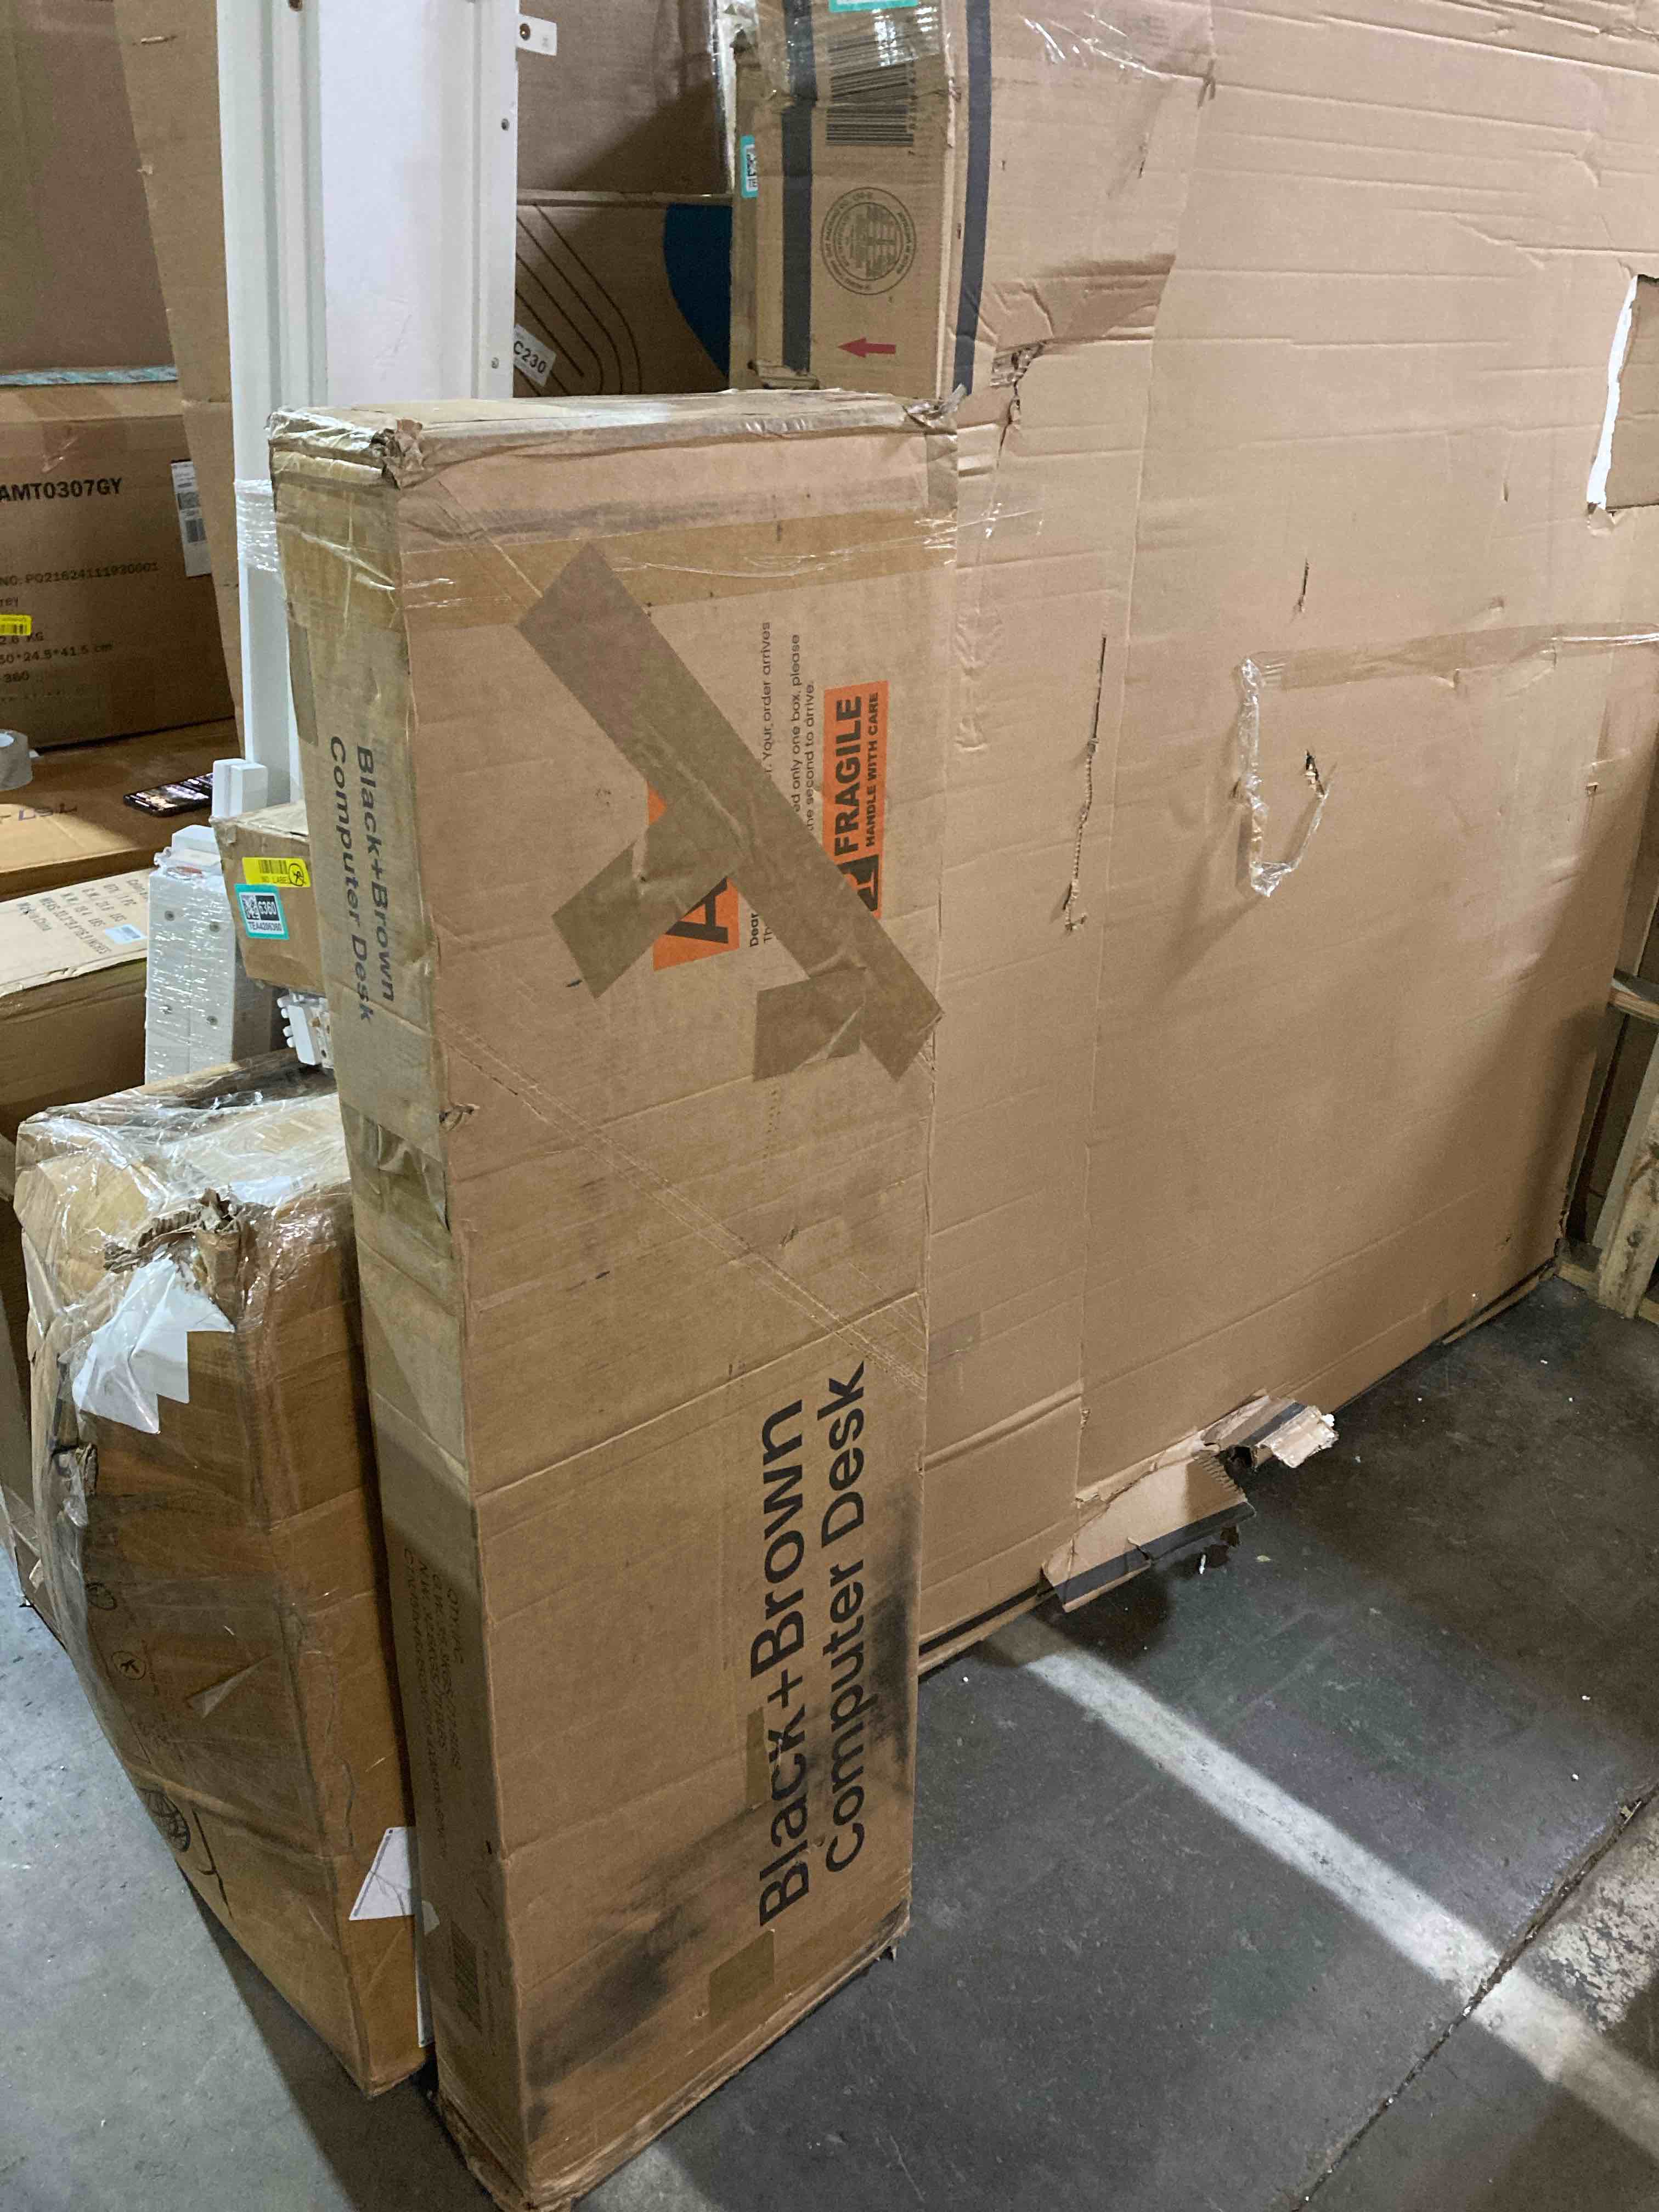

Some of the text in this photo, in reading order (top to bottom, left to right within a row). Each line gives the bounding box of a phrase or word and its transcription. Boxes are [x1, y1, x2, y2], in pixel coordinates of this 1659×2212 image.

[514, 340, 546, 374] C230
[761, 622, 771, 675] arrives
[790, 634, 802, 686] please
[761, 682, 772, 722] order
[792, 726, 801, 754] one
[804, 731, 814, 747] to
[791, 759, 803, 789] only
[804, 751, 814, 805] second
[834, 696, 862, 857] FRAGILE
[865, 692, 879, 847] HANDLE WITH CARE
[331, 736, 374, 1022] Computer Desk
[358, 745, 394, 1002] Black+Brown
[257, 901, 278, 916] 6360
[749, 912, 759, 948] Dear
[817, 1361, 877, 1872] Computer Desk
[751, 1399, 810, 1926] Black+Brown
